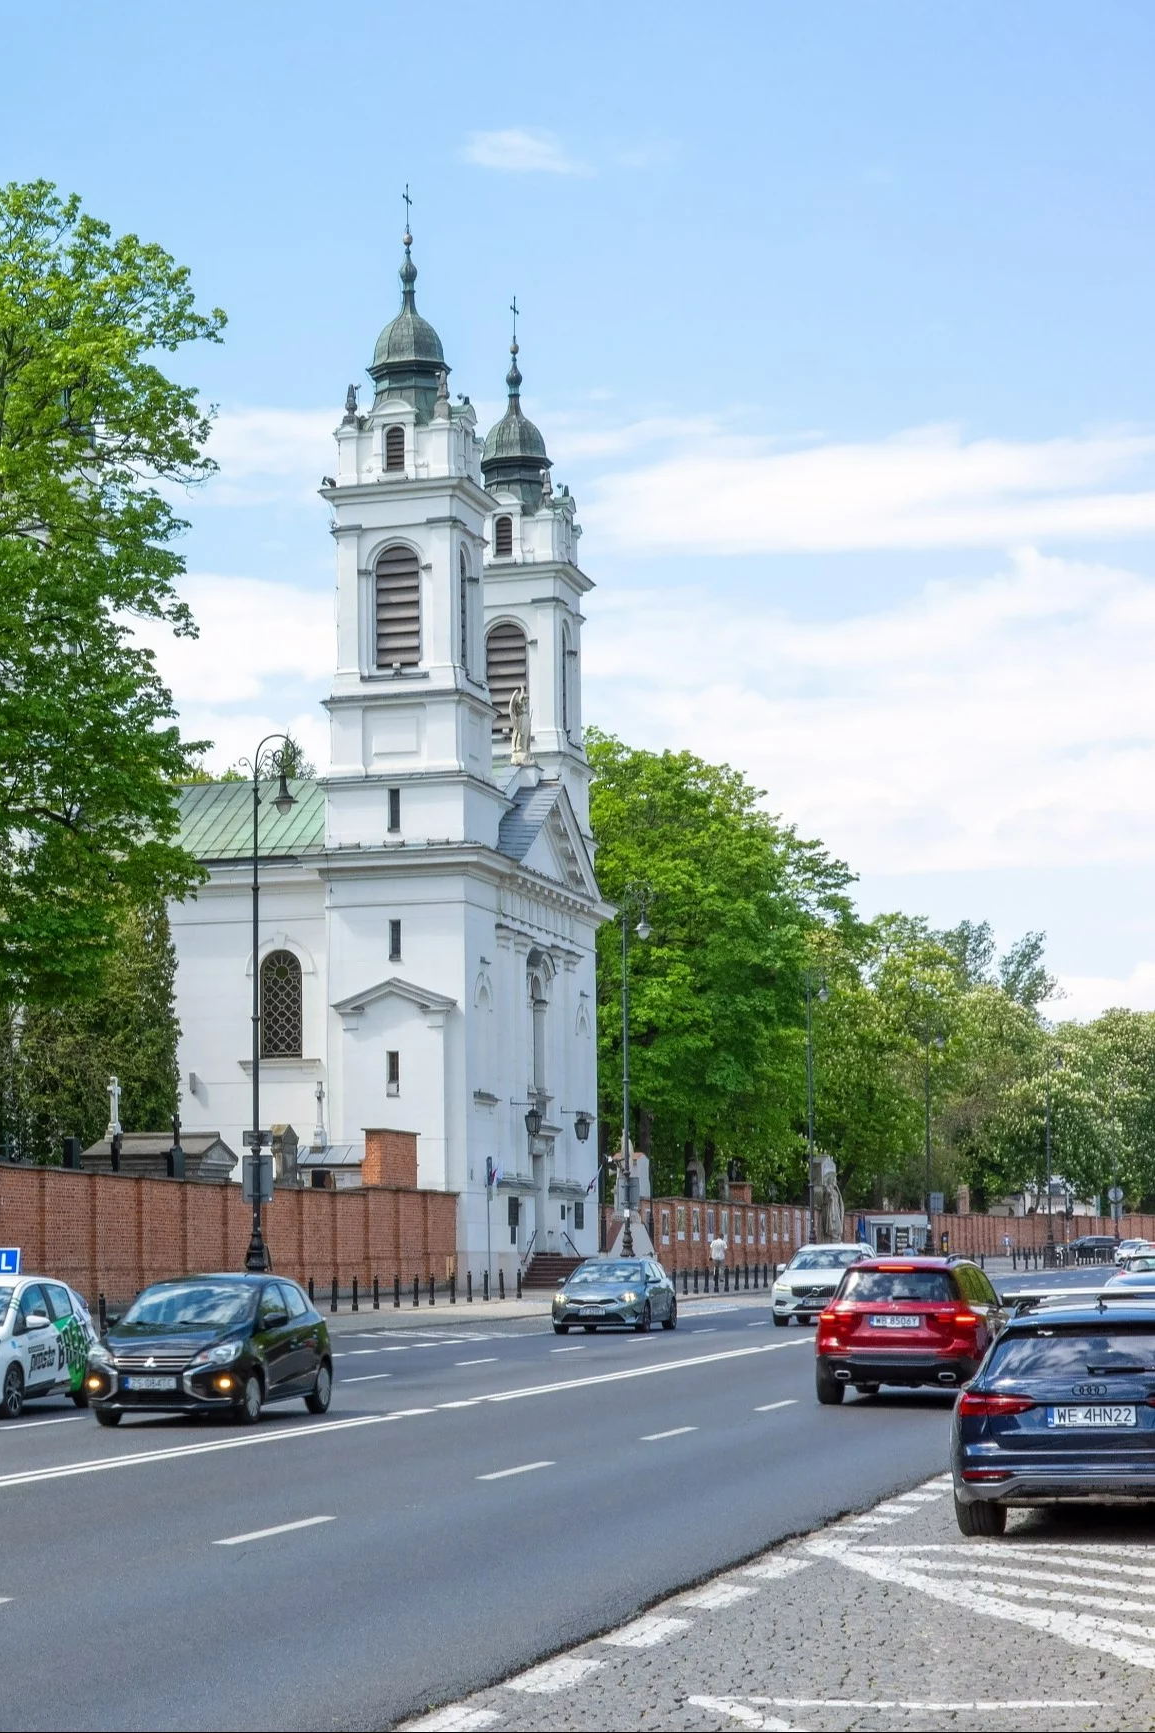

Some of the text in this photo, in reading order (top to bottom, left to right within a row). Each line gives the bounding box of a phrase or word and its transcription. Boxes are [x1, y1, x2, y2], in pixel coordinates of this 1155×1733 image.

[1, 1253, 12, 1270] L
[1057, 1407, 1132, 1422] WE 4HN22
